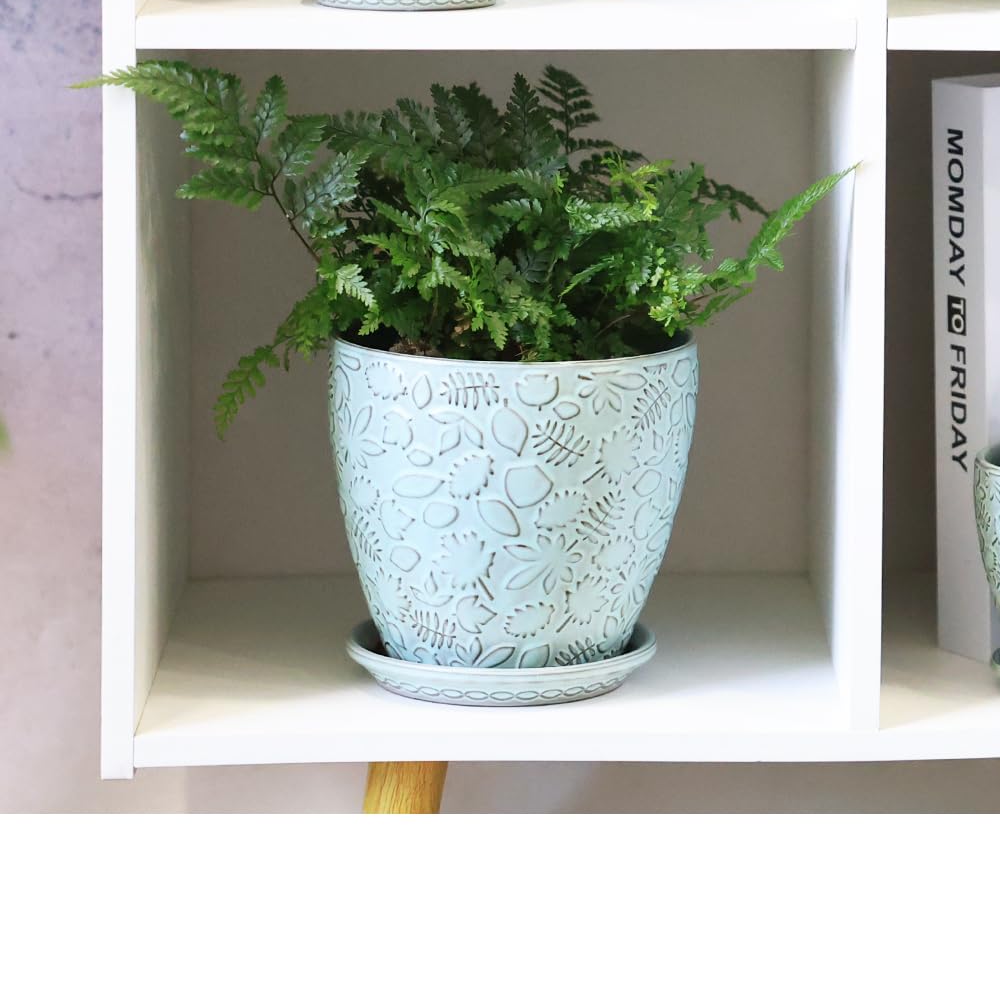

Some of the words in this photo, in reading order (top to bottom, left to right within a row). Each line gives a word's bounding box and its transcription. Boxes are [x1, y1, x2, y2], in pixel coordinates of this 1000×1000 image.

[947, 127, 966, 288] MOMDAY
[950, 297, 966, 334] TO
[950, 344, 968, 473] FRIDAY
